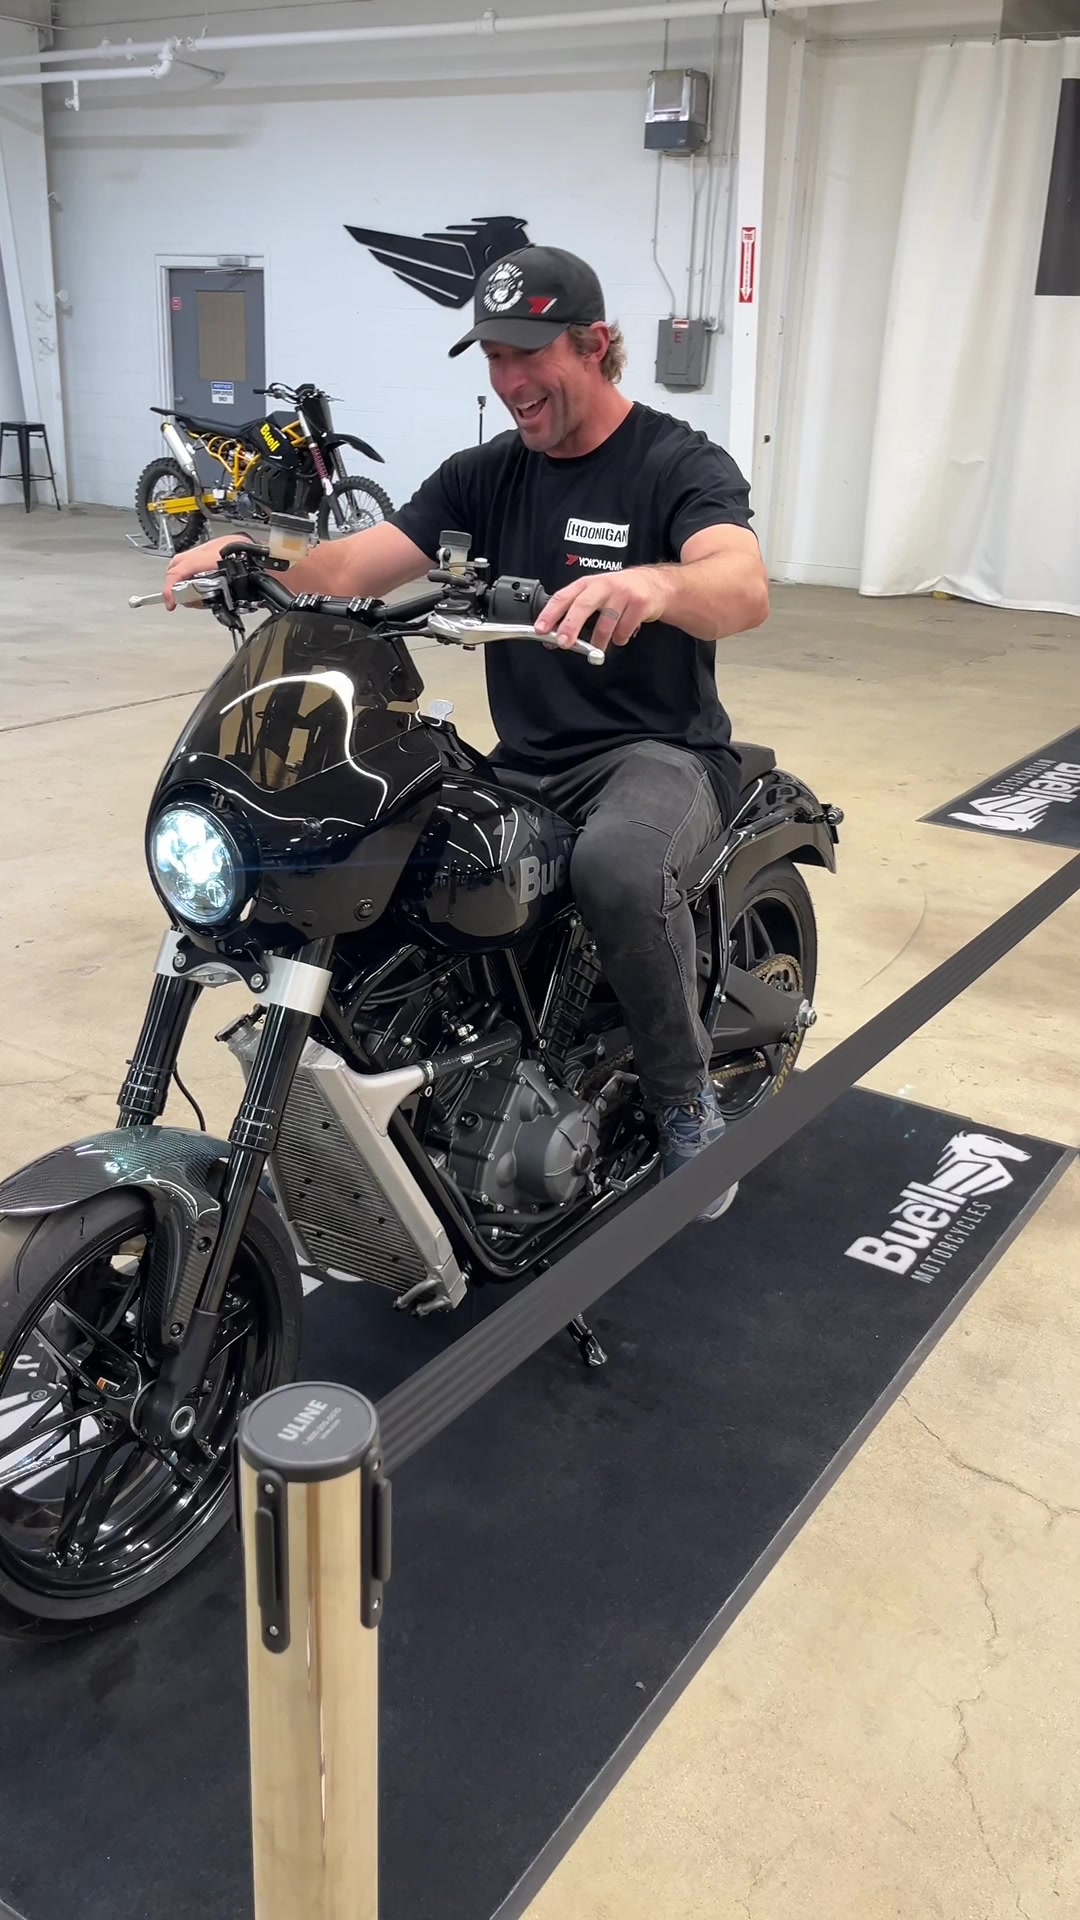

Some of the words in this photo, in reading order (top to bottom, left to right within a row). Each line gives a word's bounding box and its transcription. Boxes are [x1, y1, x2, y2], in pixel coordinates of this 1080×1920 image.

[674, 331, 682, 344] E
[843, 1181, 968, 1275] Buell
[910, 1200, 993, 1284] MOTORCYCLES
[277, 1399, 328, 1440] ULINE
